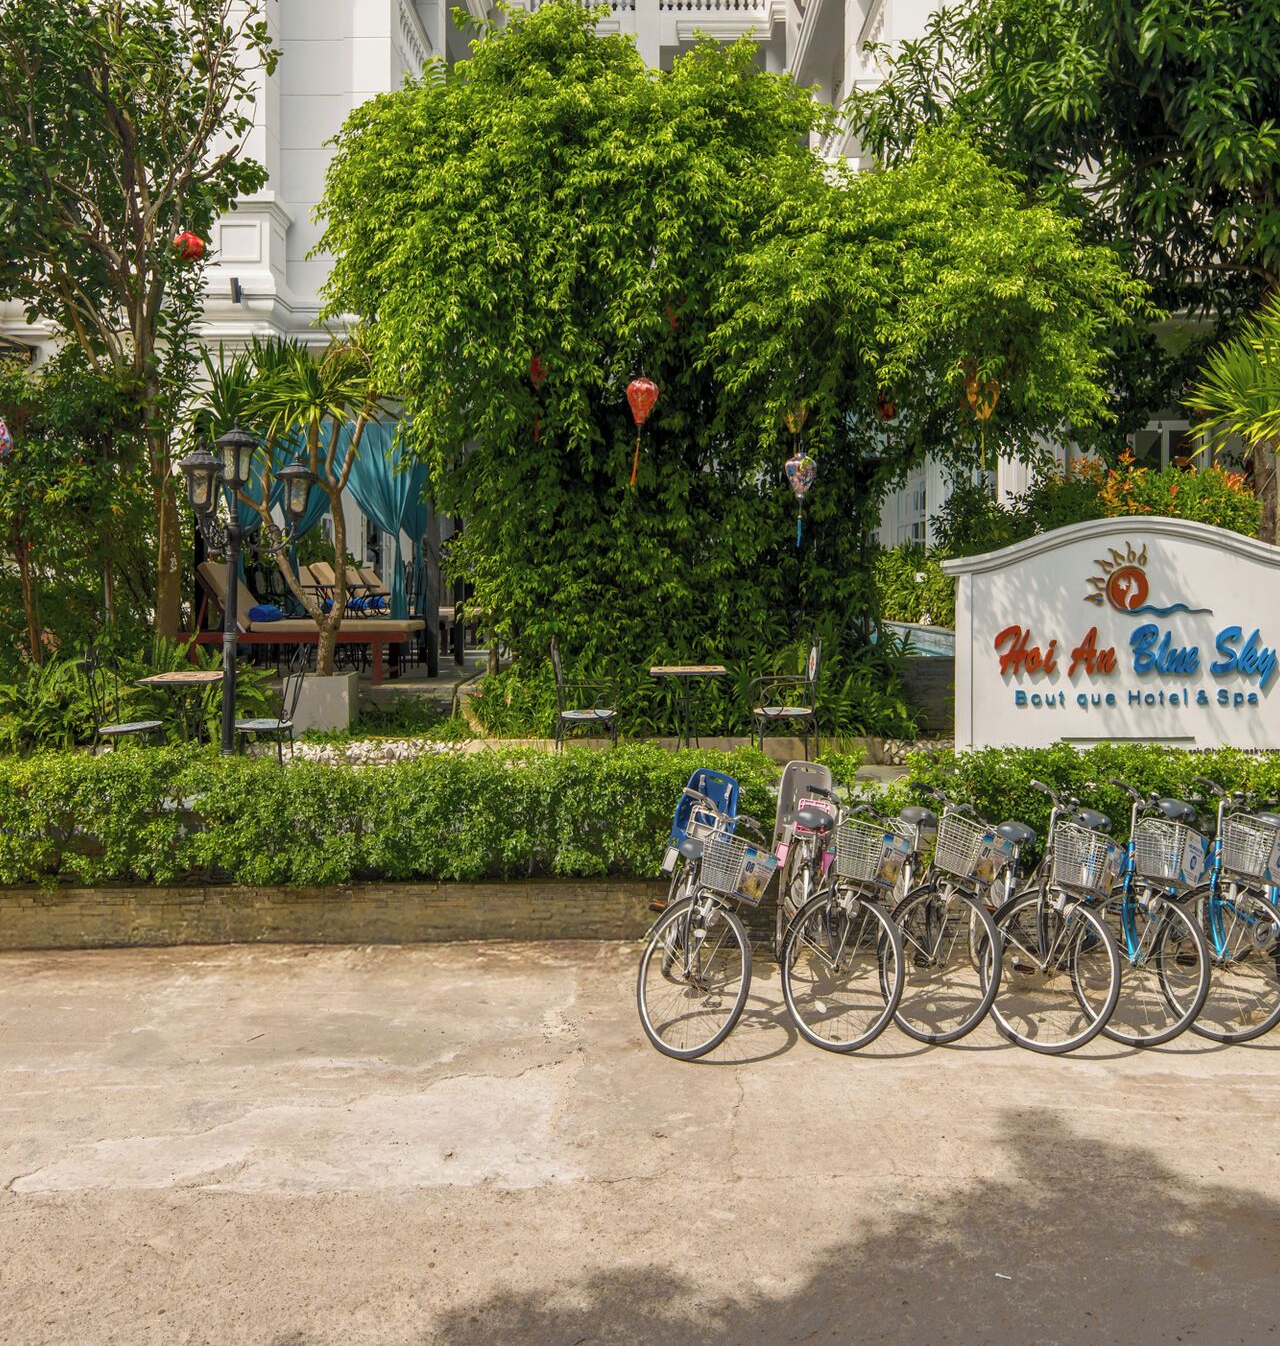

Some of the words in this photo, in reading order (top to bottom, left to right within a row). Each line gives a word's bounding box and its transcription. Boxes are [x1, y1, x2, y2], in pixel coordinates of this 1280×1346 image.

[994, 625, 1058, 676] Hoi
[1067, 626, 1118, 677] An
[1129, 623, 1201, 675] Blue
[1209, 625, 1279, 688] Sky
[1128, 688, 1189, 705] Hotel
[1196, 689, 1209, 704] &
[1216, 688, 1260, 708] Spa
